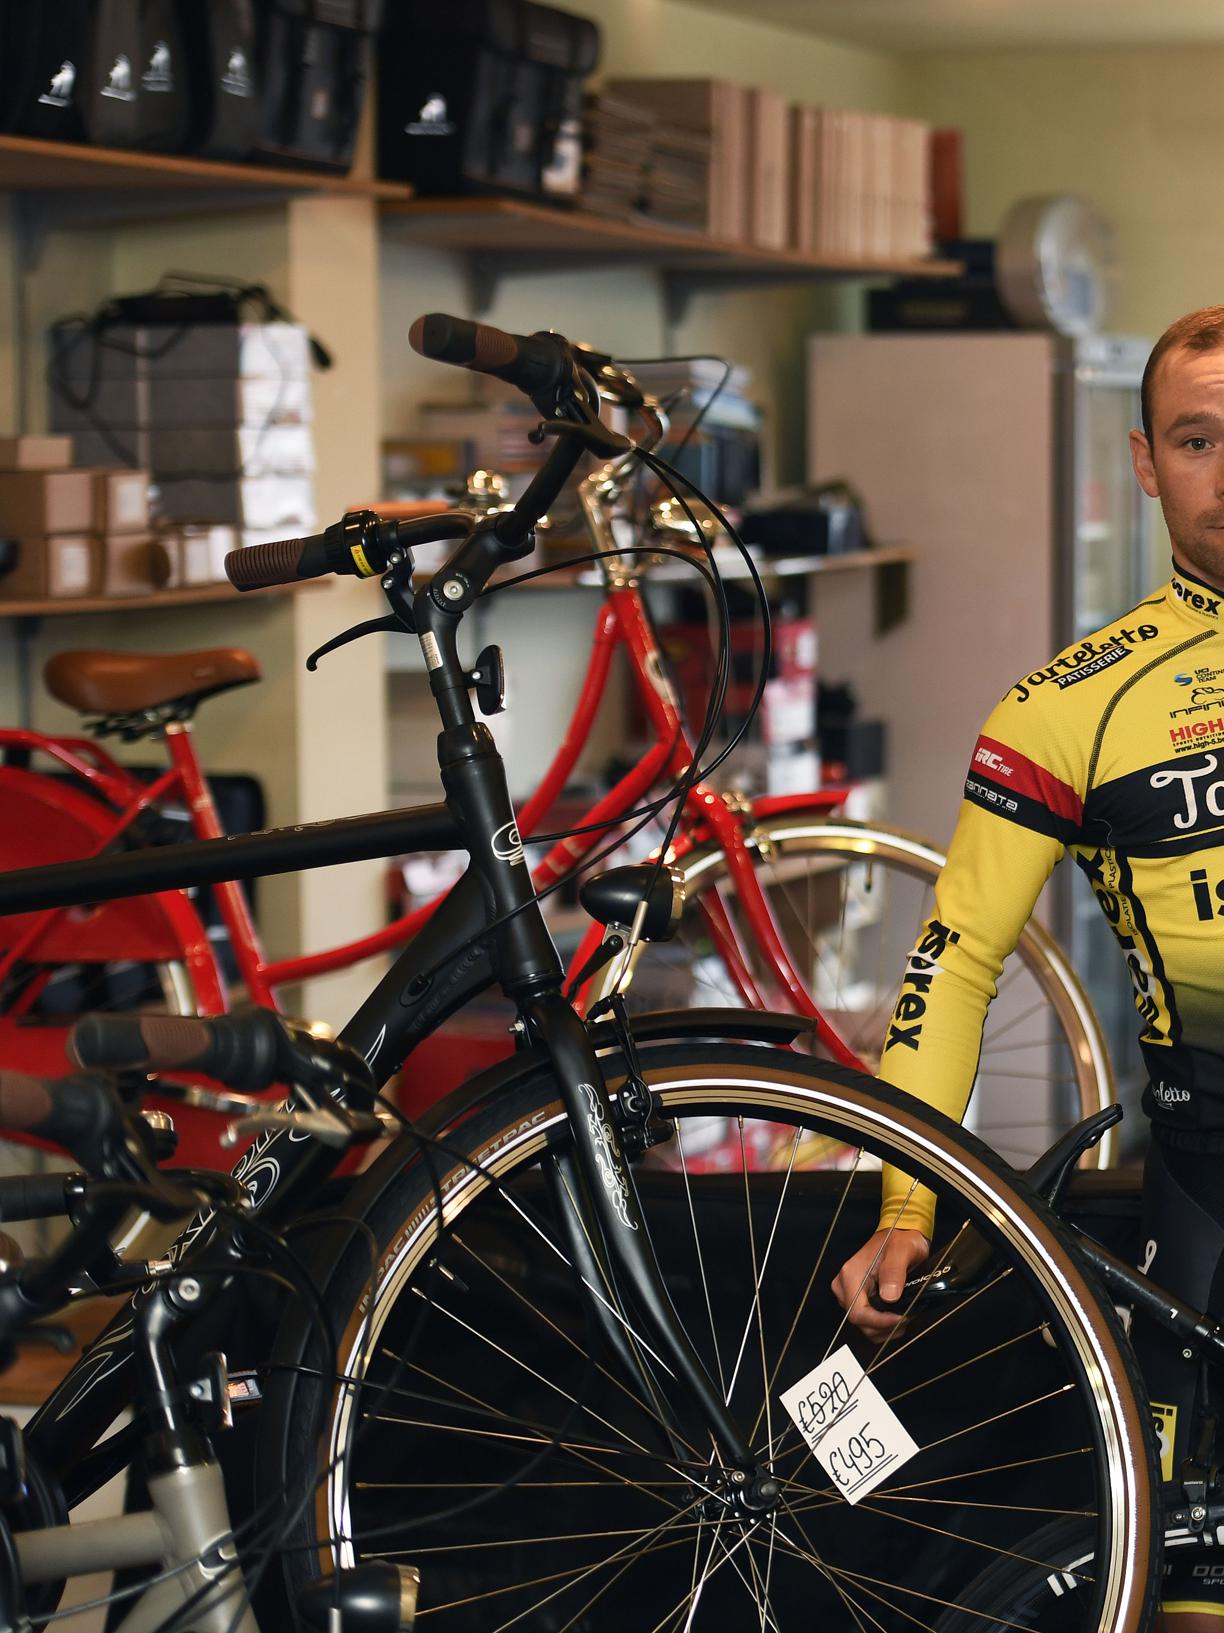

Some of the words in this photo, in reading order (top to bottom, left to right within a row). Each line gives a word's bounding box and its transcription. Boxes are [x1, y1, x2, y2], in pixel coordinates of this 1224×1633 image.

[1058, 646, 1126, 687] PATISSERIE
[996, 764, 1014, 777] TIRE
[885, 919, 961, 1052] isorex
[829, 1421, 886, 1487] €495
